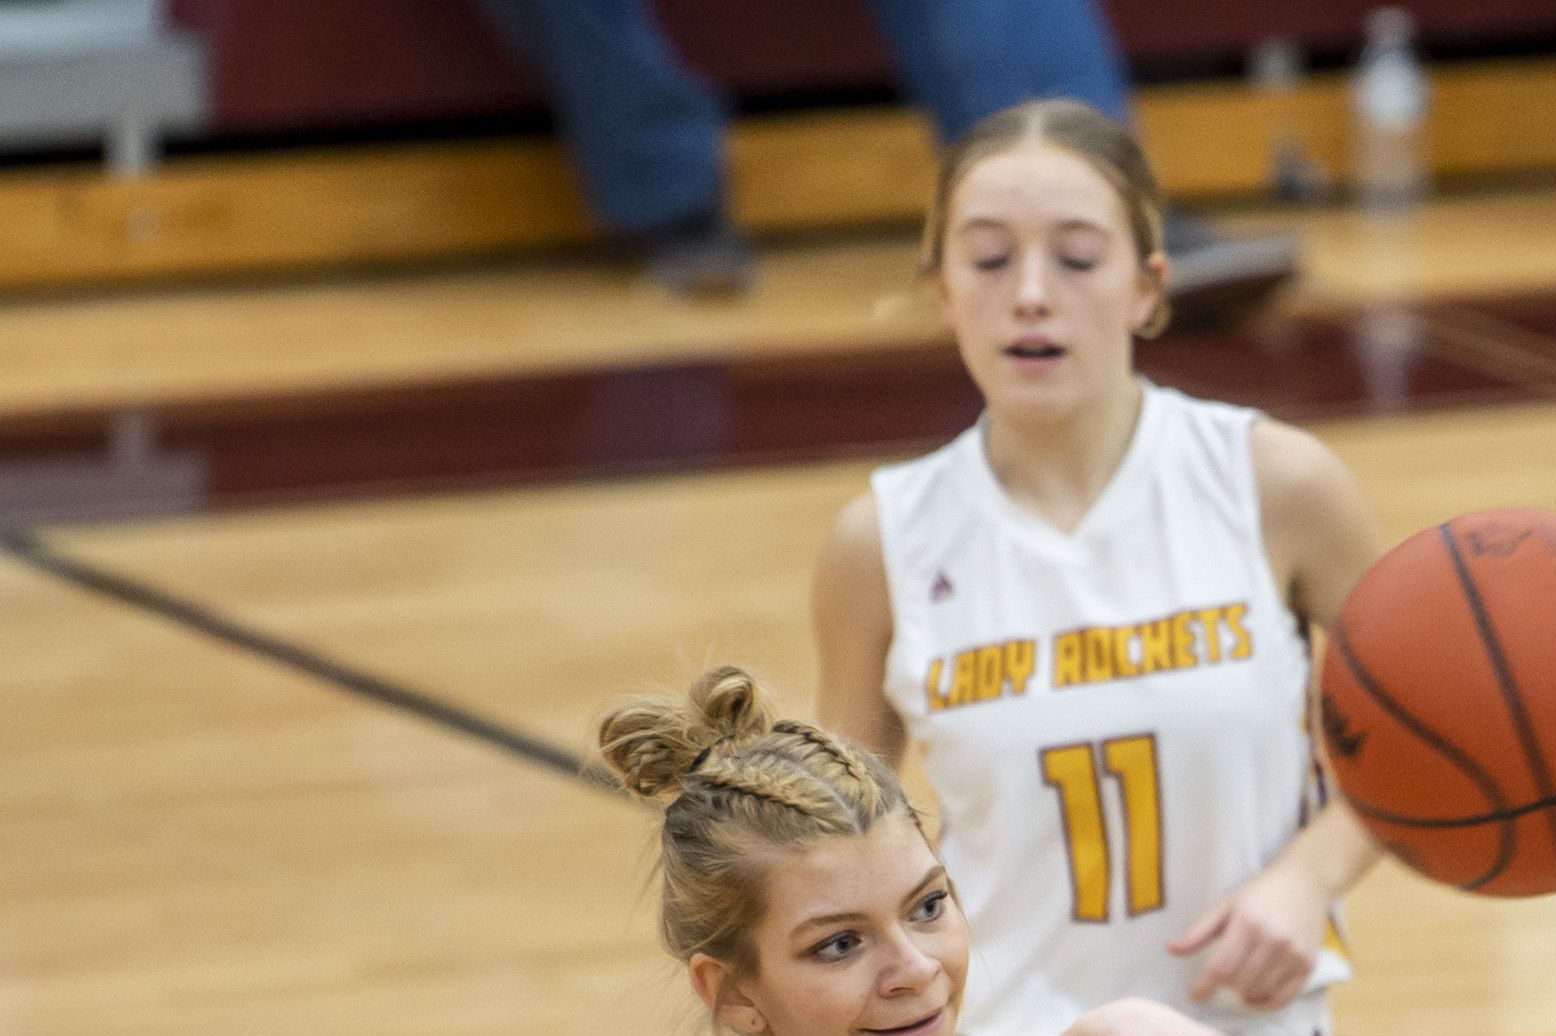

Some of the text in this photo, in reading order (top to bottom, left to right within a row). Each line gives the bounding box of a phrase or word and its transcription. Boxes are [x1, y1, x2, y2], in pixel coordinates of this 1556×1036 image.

[925, 602, 1253, 713] LADY ROCKETS
[1038, 731, 1165, 924] 11
